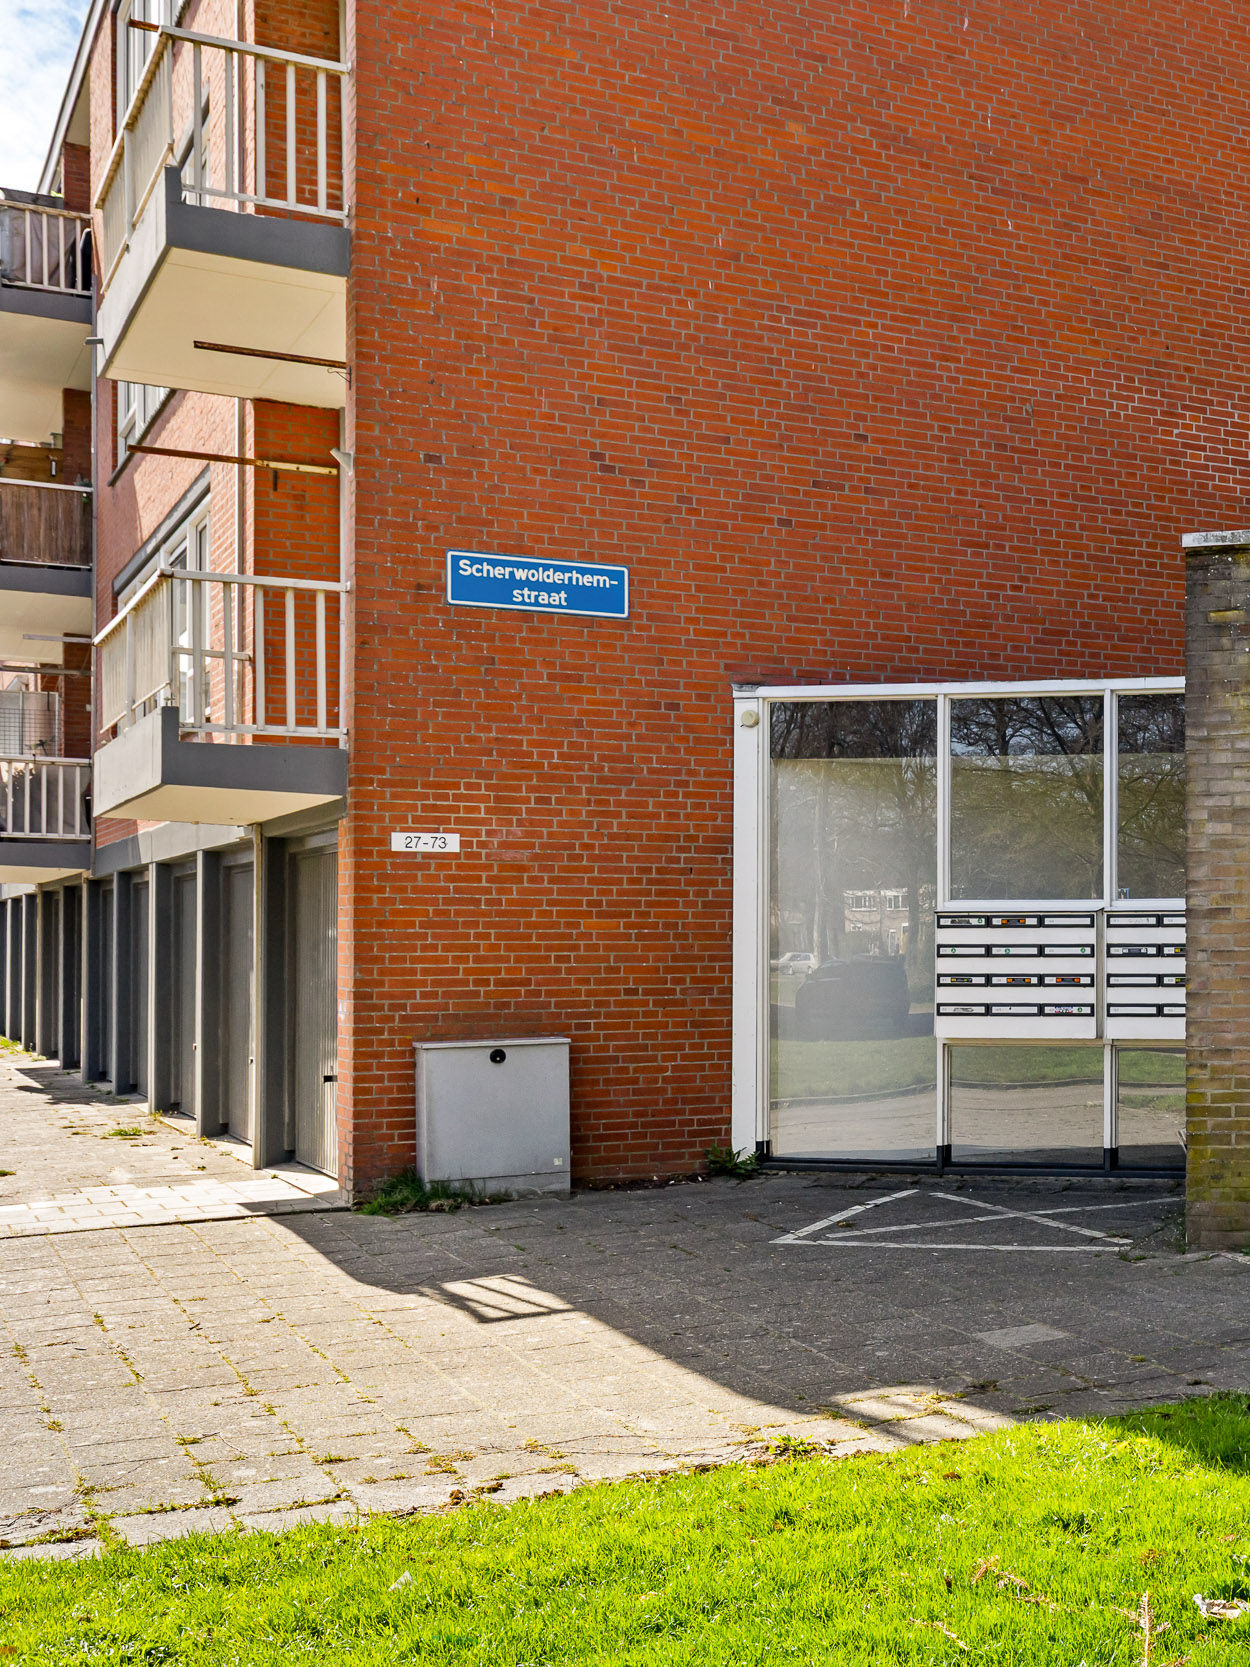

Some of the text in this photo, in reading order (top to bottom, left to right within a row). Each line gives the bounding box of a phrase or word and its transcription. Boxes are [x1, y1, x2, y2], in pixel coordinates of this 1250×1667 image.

[458, 559, 618, 588] Scherwolderhem-
[512, 587, 568, 606] straat
[404, 835, 447, 849] 27-73
